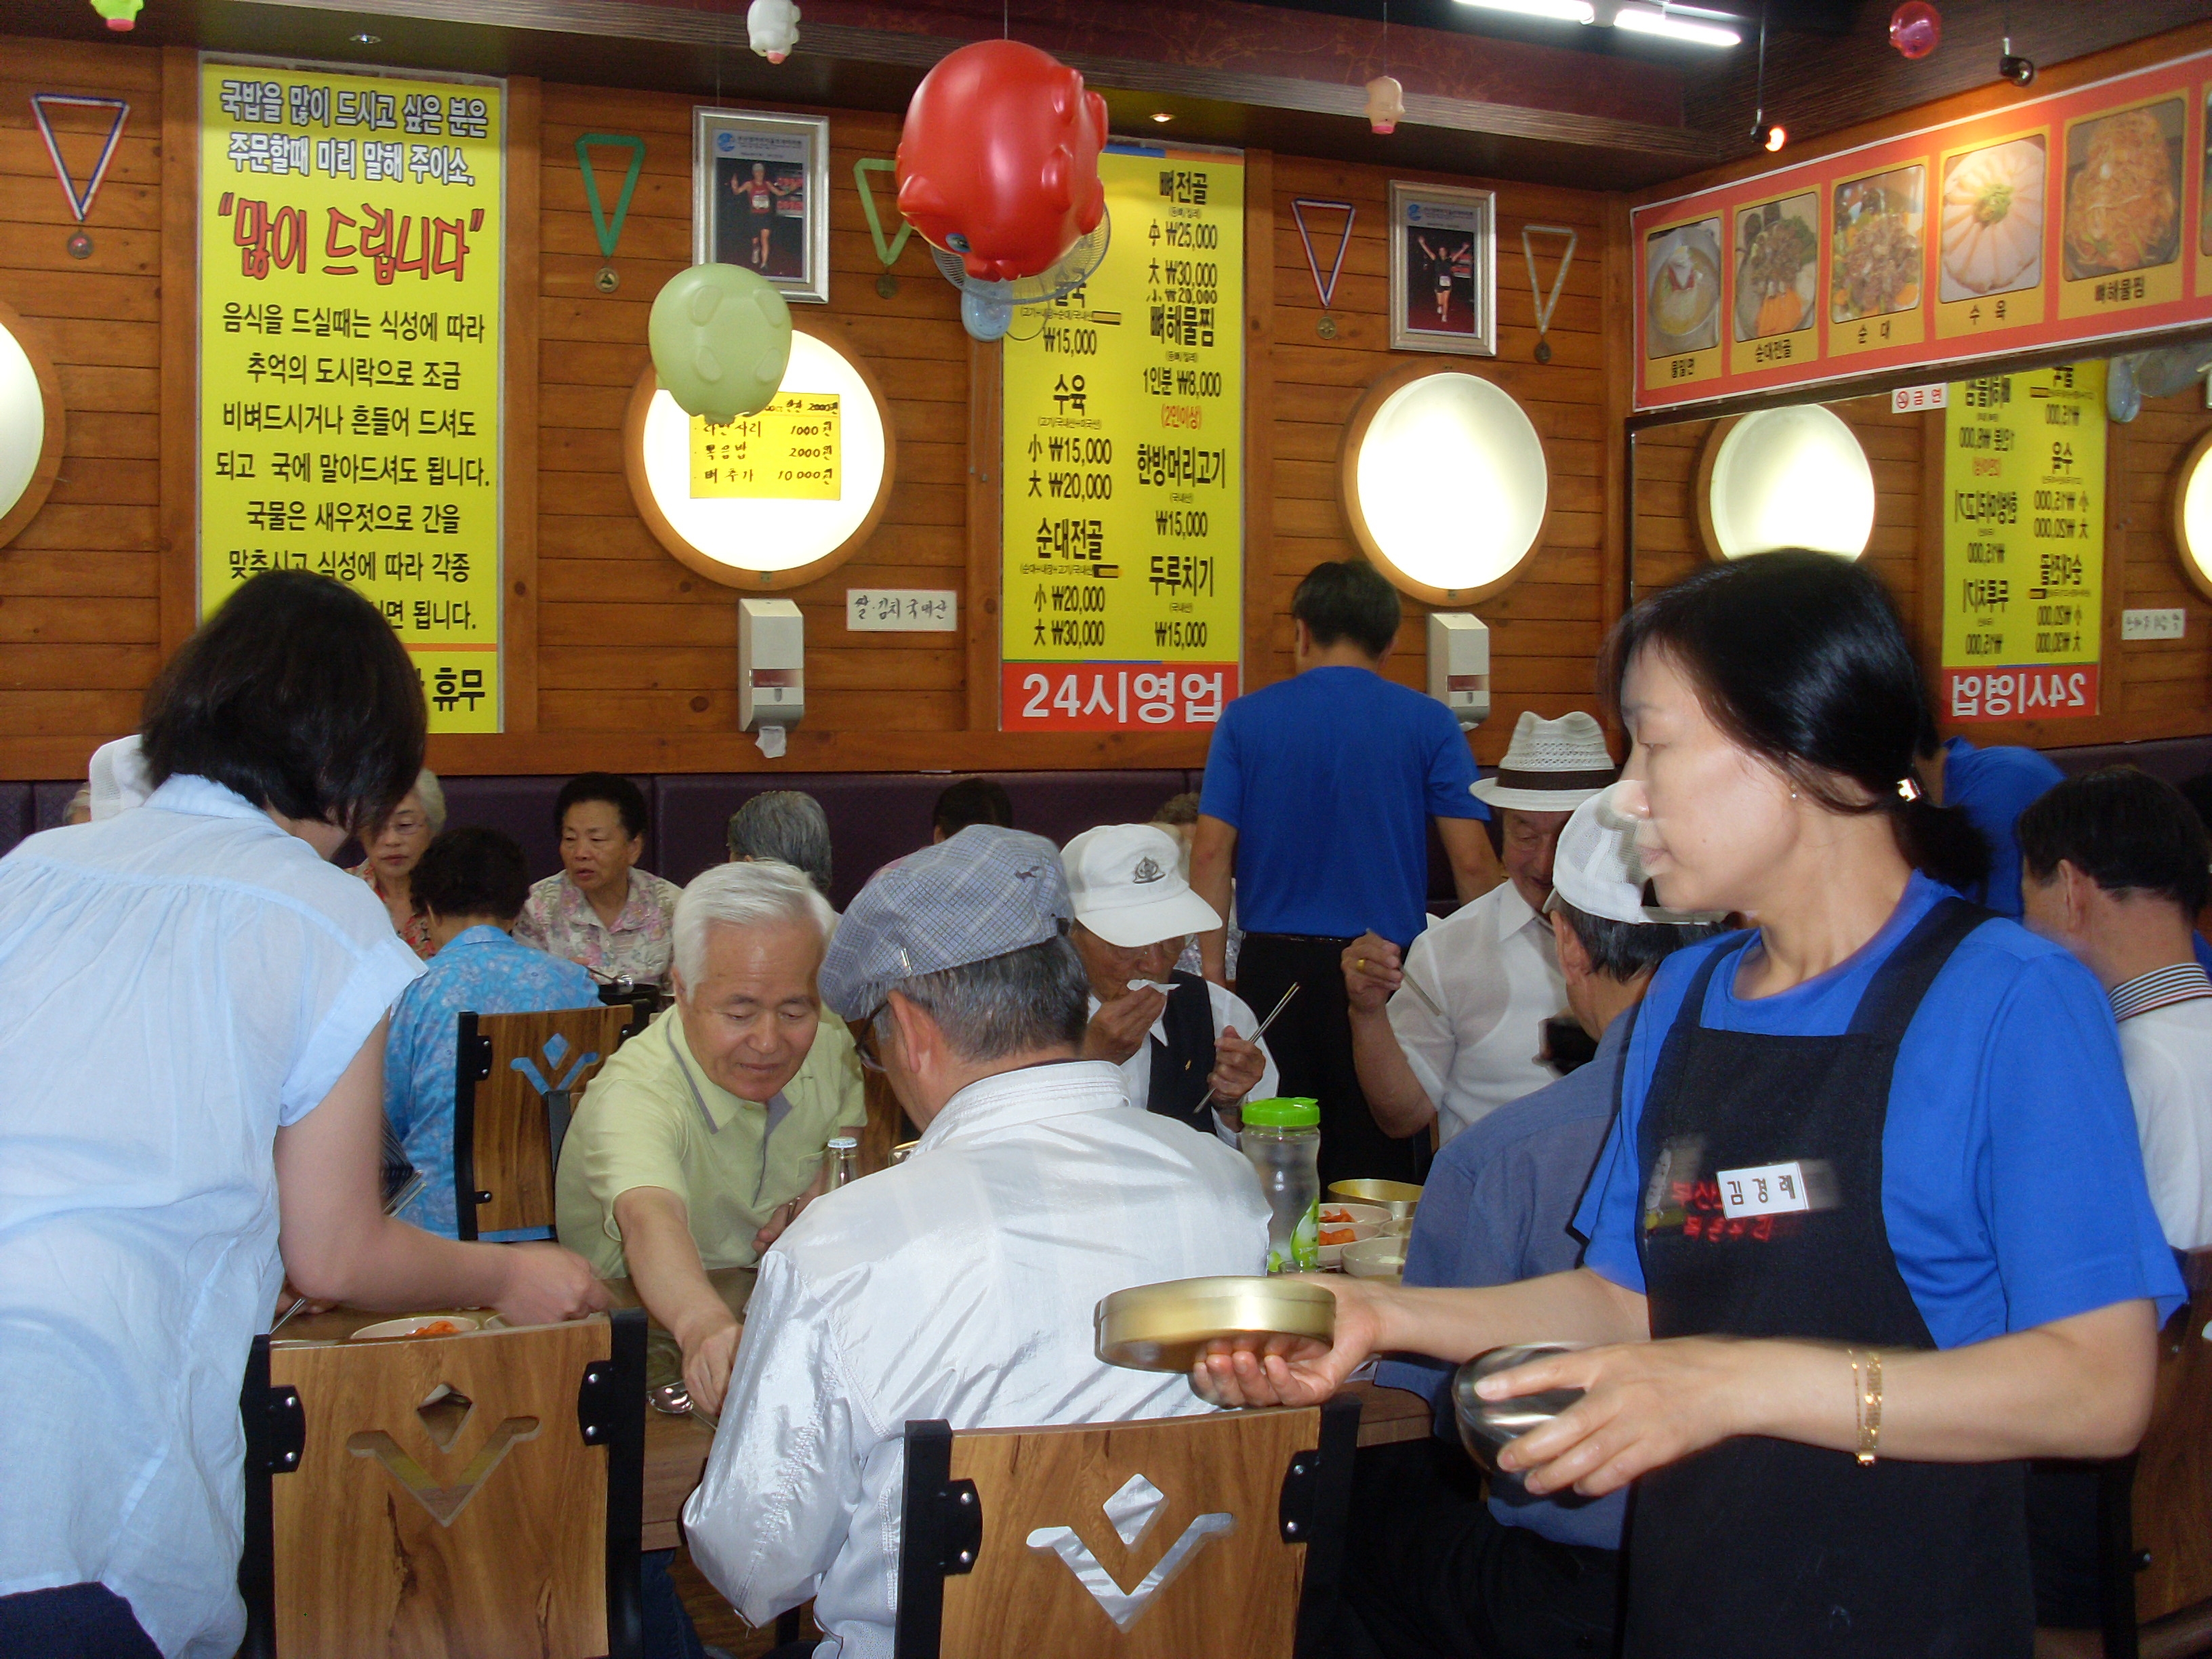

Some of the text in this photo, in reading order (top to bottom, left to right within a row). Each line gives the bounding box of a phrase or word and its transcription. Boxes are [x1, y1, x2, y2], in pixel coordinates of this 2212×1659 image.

[220, 79, 489, 139] 국밥을 많이 드시고 싶은 분은
[227, 133, 310, 177] 주문할때
[316, 138, 356, 180] 미리
[363, 141, 403, 183] 말해
[1160, 170, 1208, 205] 뼈전골
[1166, 221, 1217, 249] ₩25,000
[1149, 258, 1217, 288] 大 ₩30,000
[1166, 287, 1218, 305] ₩20,000
[223, 302, 485, 344] 음식을 드실때는 식성에 따라
[1149, 304, 1214, 347] 뼈해물찜
[247, 352, 461, 390] 추억의 도시락으로 조금
[1143, 367, 1221, 397] 1인분 ₩8,000
[1053, 374, 1086, 416] 수육
[224, 401, 476, 438] 비벼드시거나 흔들어 드셔도
[1049, 436, 1111, 466] ₩15,000
[1137, 444, 1225, 489] 한방머리고기
[216, 451, 489, 487] 되고 국에 말아드셔도 됩니다.
[1028, 470, 1111, 501] 大 ₩20,000
[247, 501, 460, 534] 국물은 새우젓으로 간을
[1155, 511, 1208, 541] ₩15,000
[1036, 518, 1103, 560] 순대전골
[318, 551, 375, 581] 식성에
[386, 552, 424, 581] 따라
[432, 553, 470, 582] 각종
[1149, 556, 1213, 597] 두루치기
[380, 600, 476, 630] 면 됩니다.
[1052, 586, 1105, 614] ₩20,000
[1034, 619, 1104, 649] 大 ₩30,000
[1155, 621, 1207, 651] ₩15,000
[432, 668, 485, 712] 휴무
[1022, 672, 1223, 723] 24시영업
